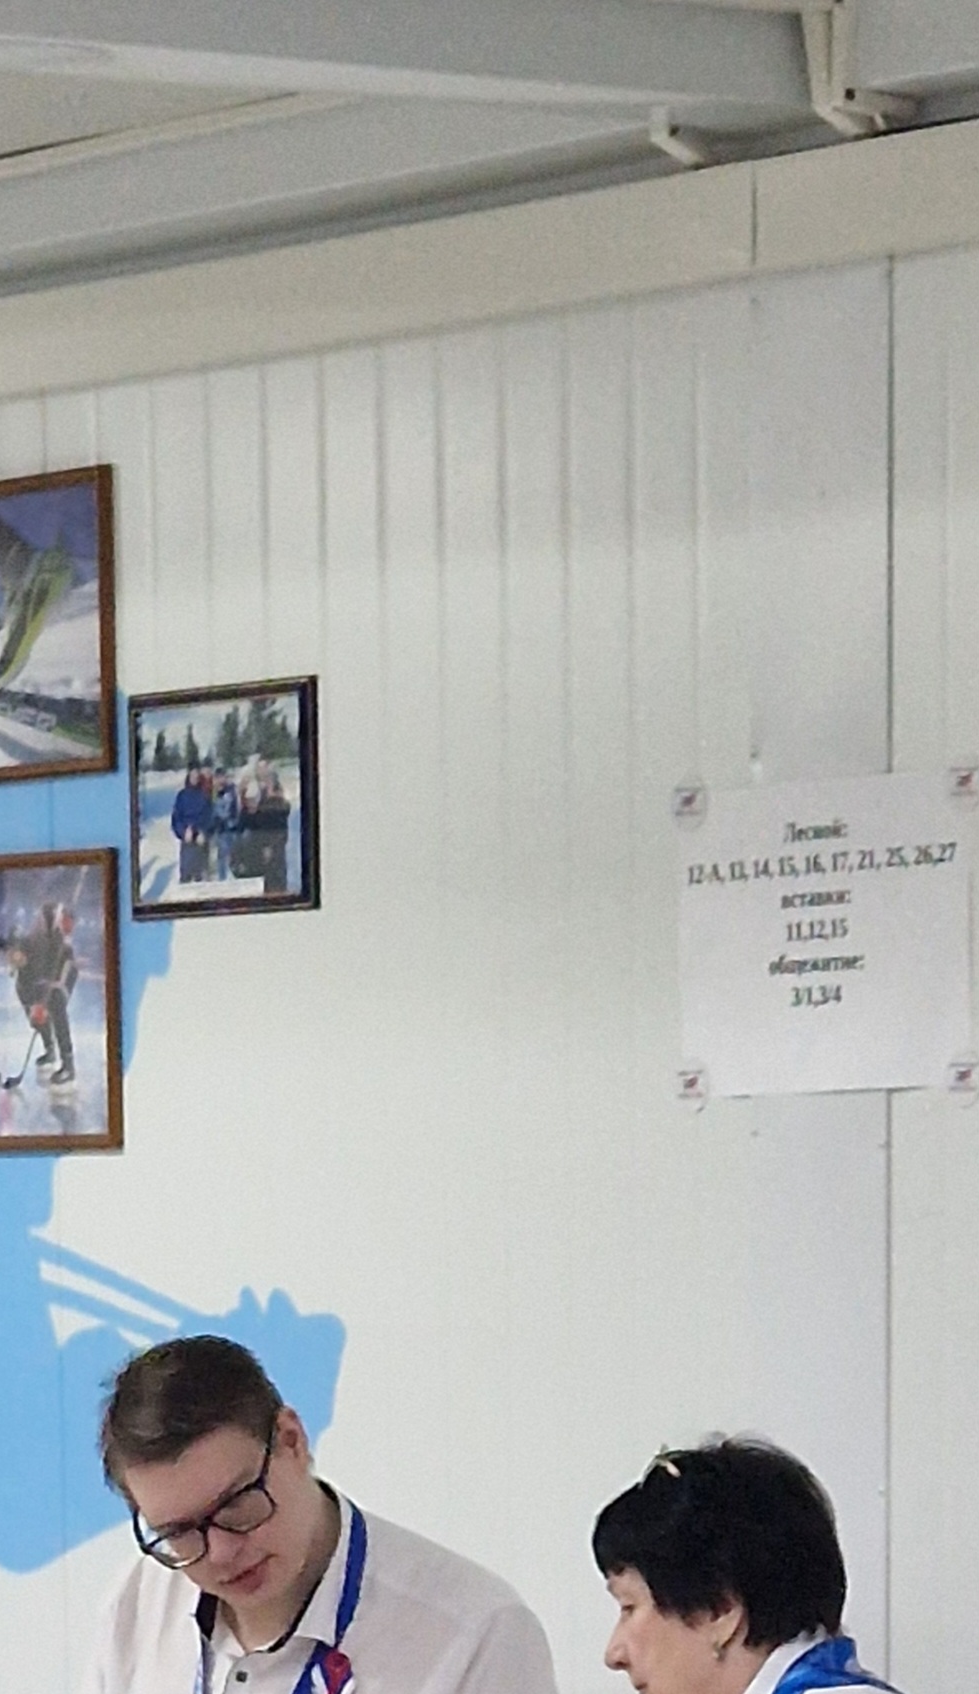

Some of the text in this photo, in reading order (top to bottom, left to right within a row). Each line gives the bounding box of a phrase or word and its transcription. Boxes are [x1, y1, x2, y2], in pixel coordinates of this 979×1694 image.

[831, 851, 854, 874] 17,
[857, 848, 882, 871] 21,
[886, 846, 910, 870] 25,
